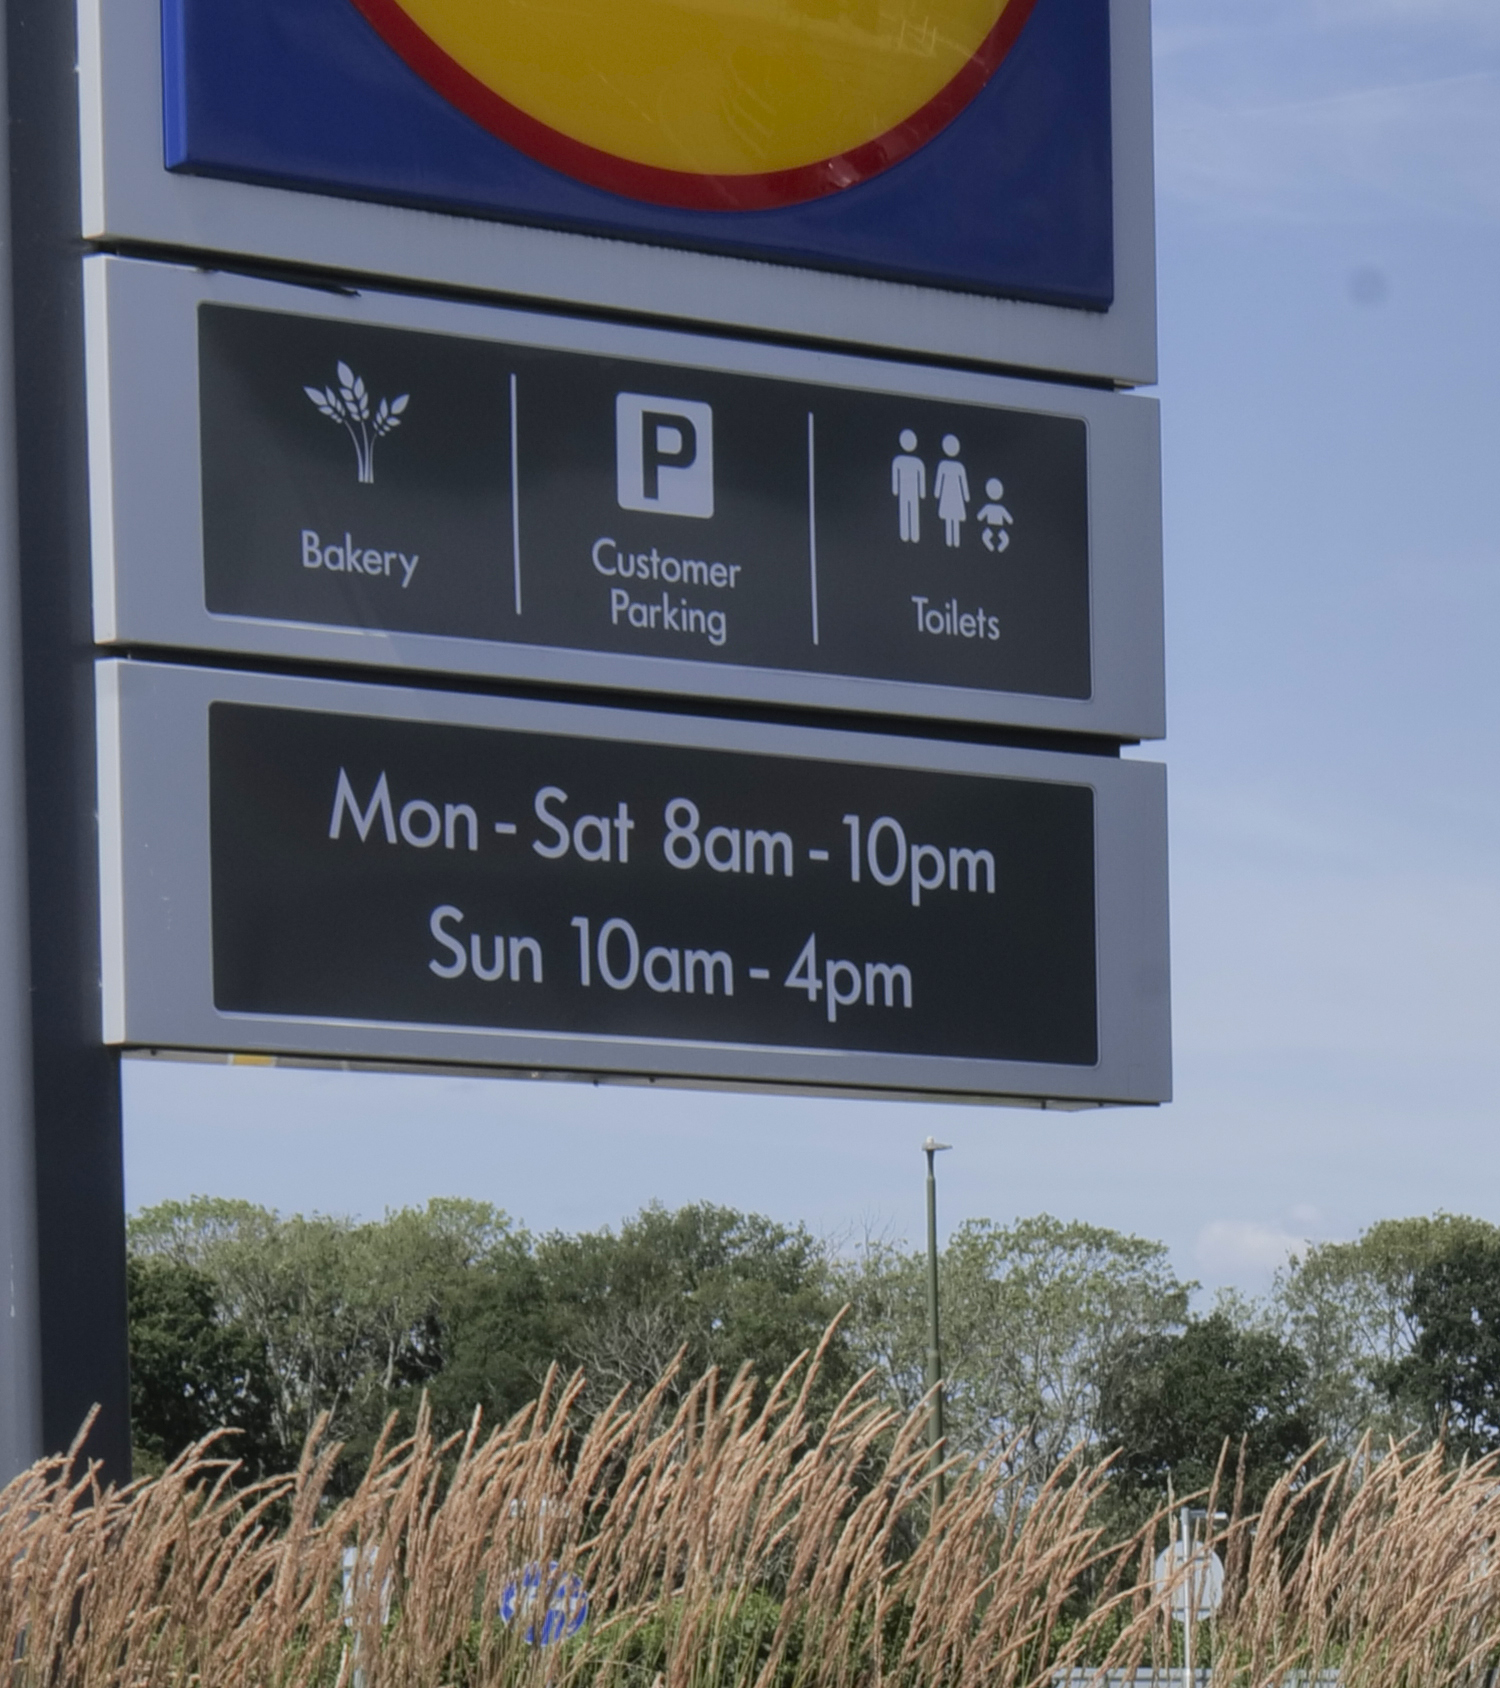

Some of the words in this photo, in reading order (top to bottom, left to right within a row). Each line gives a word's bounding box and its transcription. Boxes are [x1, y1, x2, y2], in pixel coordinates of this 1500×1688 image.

[300, 531, 420, 588] Bakery
[592, 538, 742, 591] Customer
[610, 588, 728, 647] Parking
[911, 596, 1002, 642] Toilets
[428, 905, 543, 984] Sun
